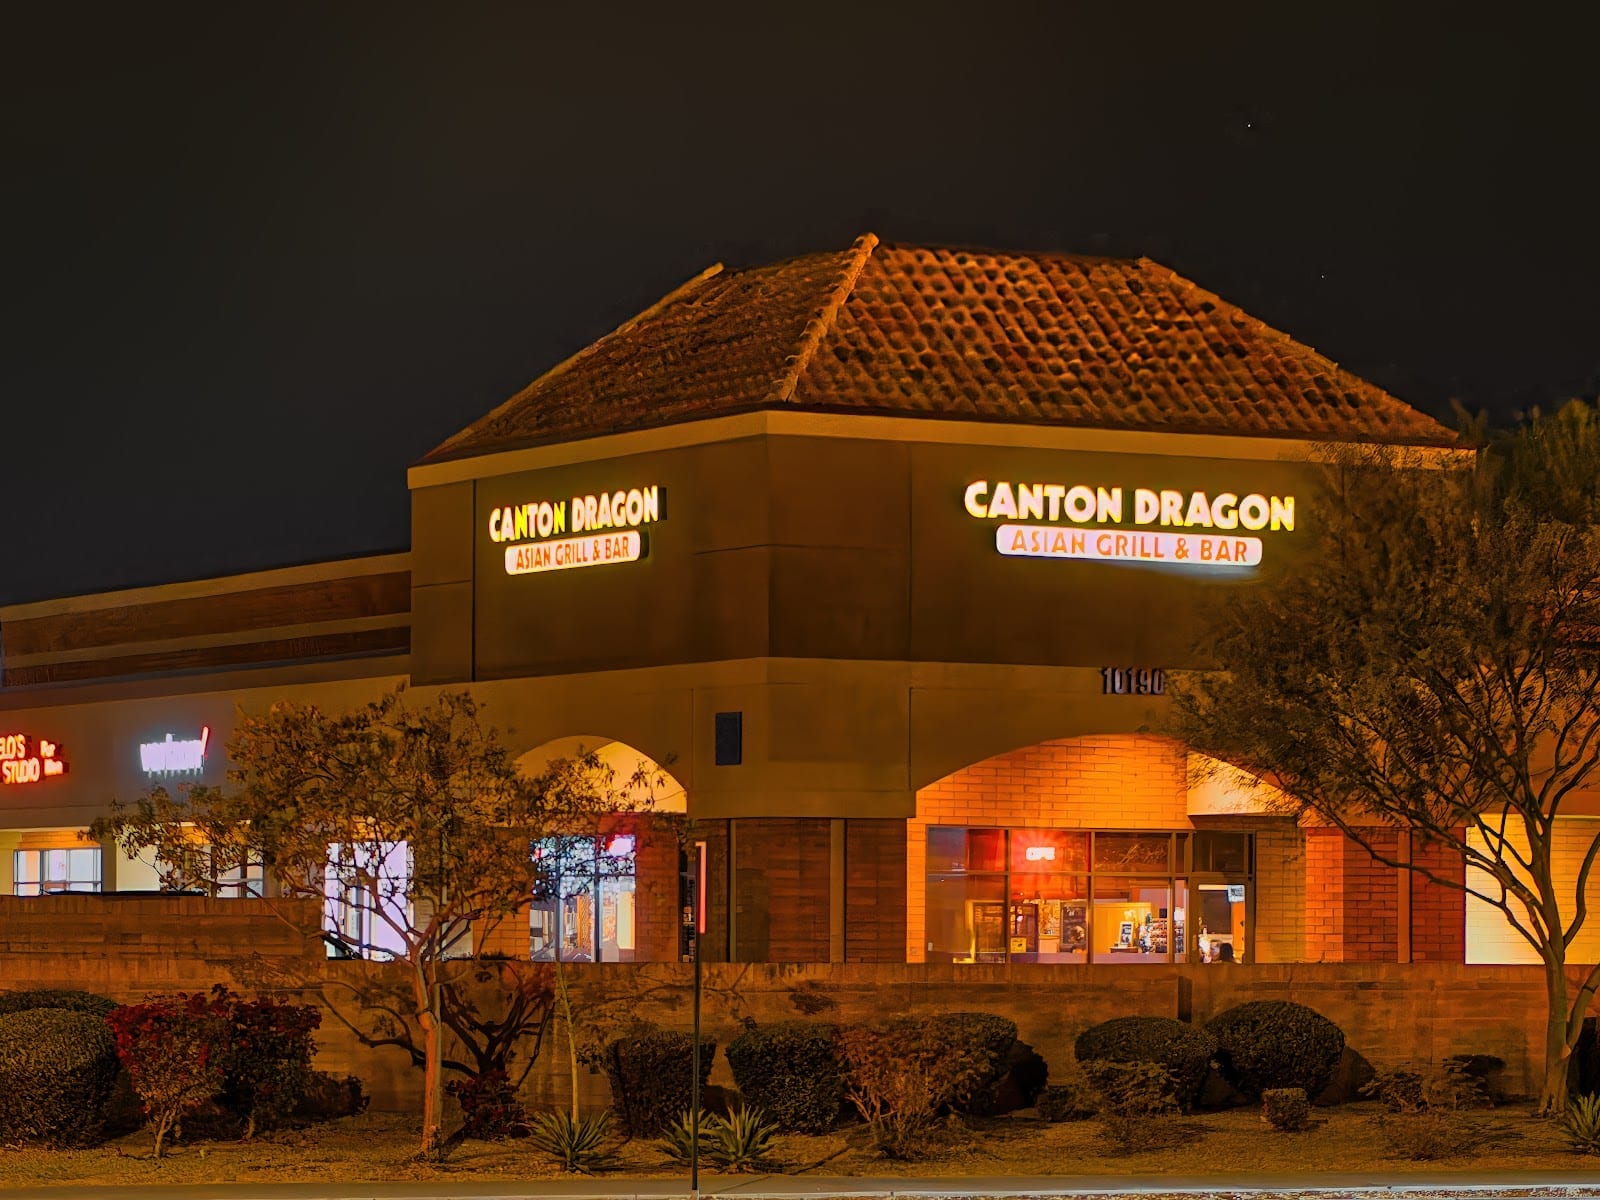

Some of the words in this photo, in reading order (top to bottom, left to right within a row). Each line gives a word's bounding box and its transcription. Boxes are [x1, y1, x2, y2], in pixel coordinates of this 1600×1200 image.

[489, 501, 566, 542] CANTON
[572, 485, 659, 532] DRAGON
[965, 480, 1122, 523] CANTON
[1135, 488, 1295, 531] DRAGON
[516, 550, 551, 570] ASIAN
[555, 543, 588, 566] GRILL
[593, 539, 600, 561] &
[605, 536, 629, 559] BAR
[1011, 529, 1086, 554] ASIAN
[1096, 533, 1165, 558] GRILL
[1175, 537, 1190, 559] &
[1200, 538, 1248, 562] BAR
[1102, 667, 1165, 694] 10190
